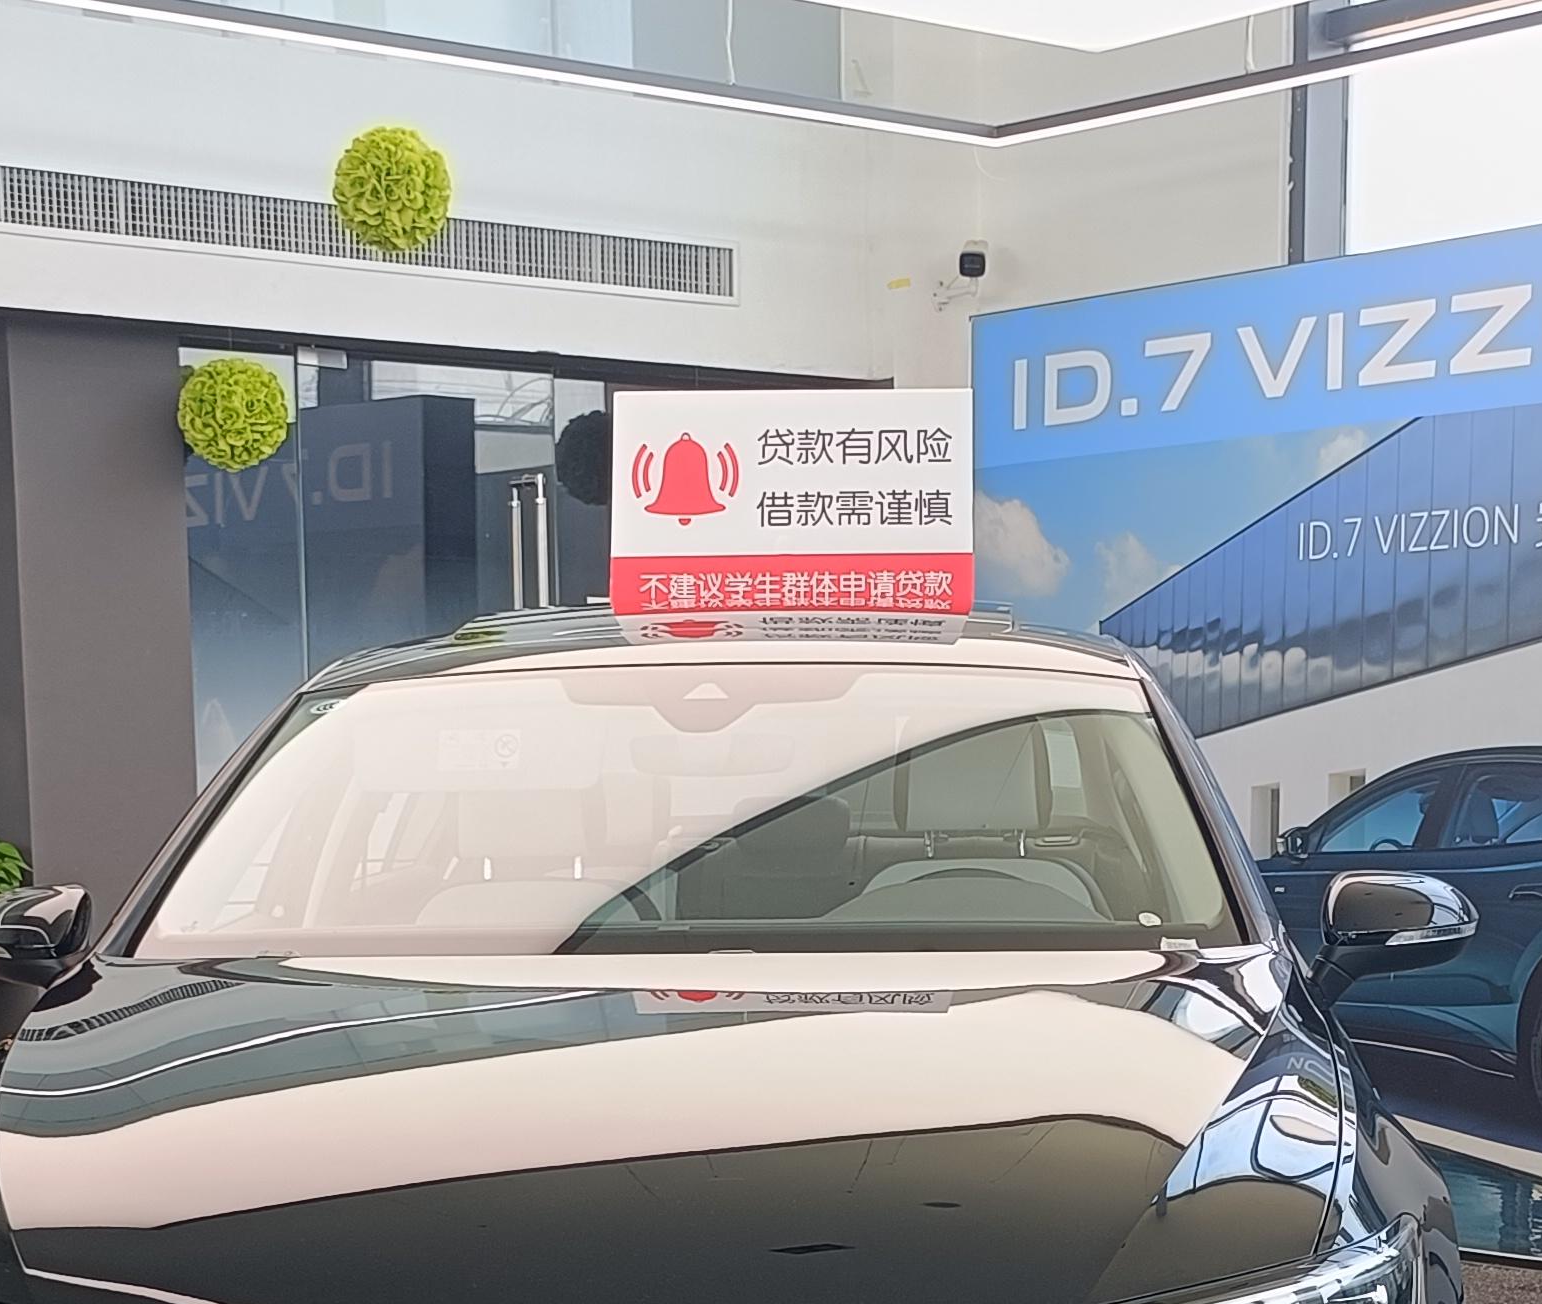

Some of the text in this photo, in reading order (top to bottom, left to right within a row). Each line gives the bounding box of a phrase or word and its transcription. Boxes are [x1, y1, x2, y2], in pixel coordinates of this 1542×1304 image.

[1013, 331, 1213, 430] ID.7
[757, 427, 953, 465] 贷款有风险
[756, 489, 953, 527] 借款需谨慎
[1297, 516, 1363, 561] ID.7
[1374, 502, 1521, 554] VIZZION
[638, 570, 953, 600] 不建议学生群体申请贷款
